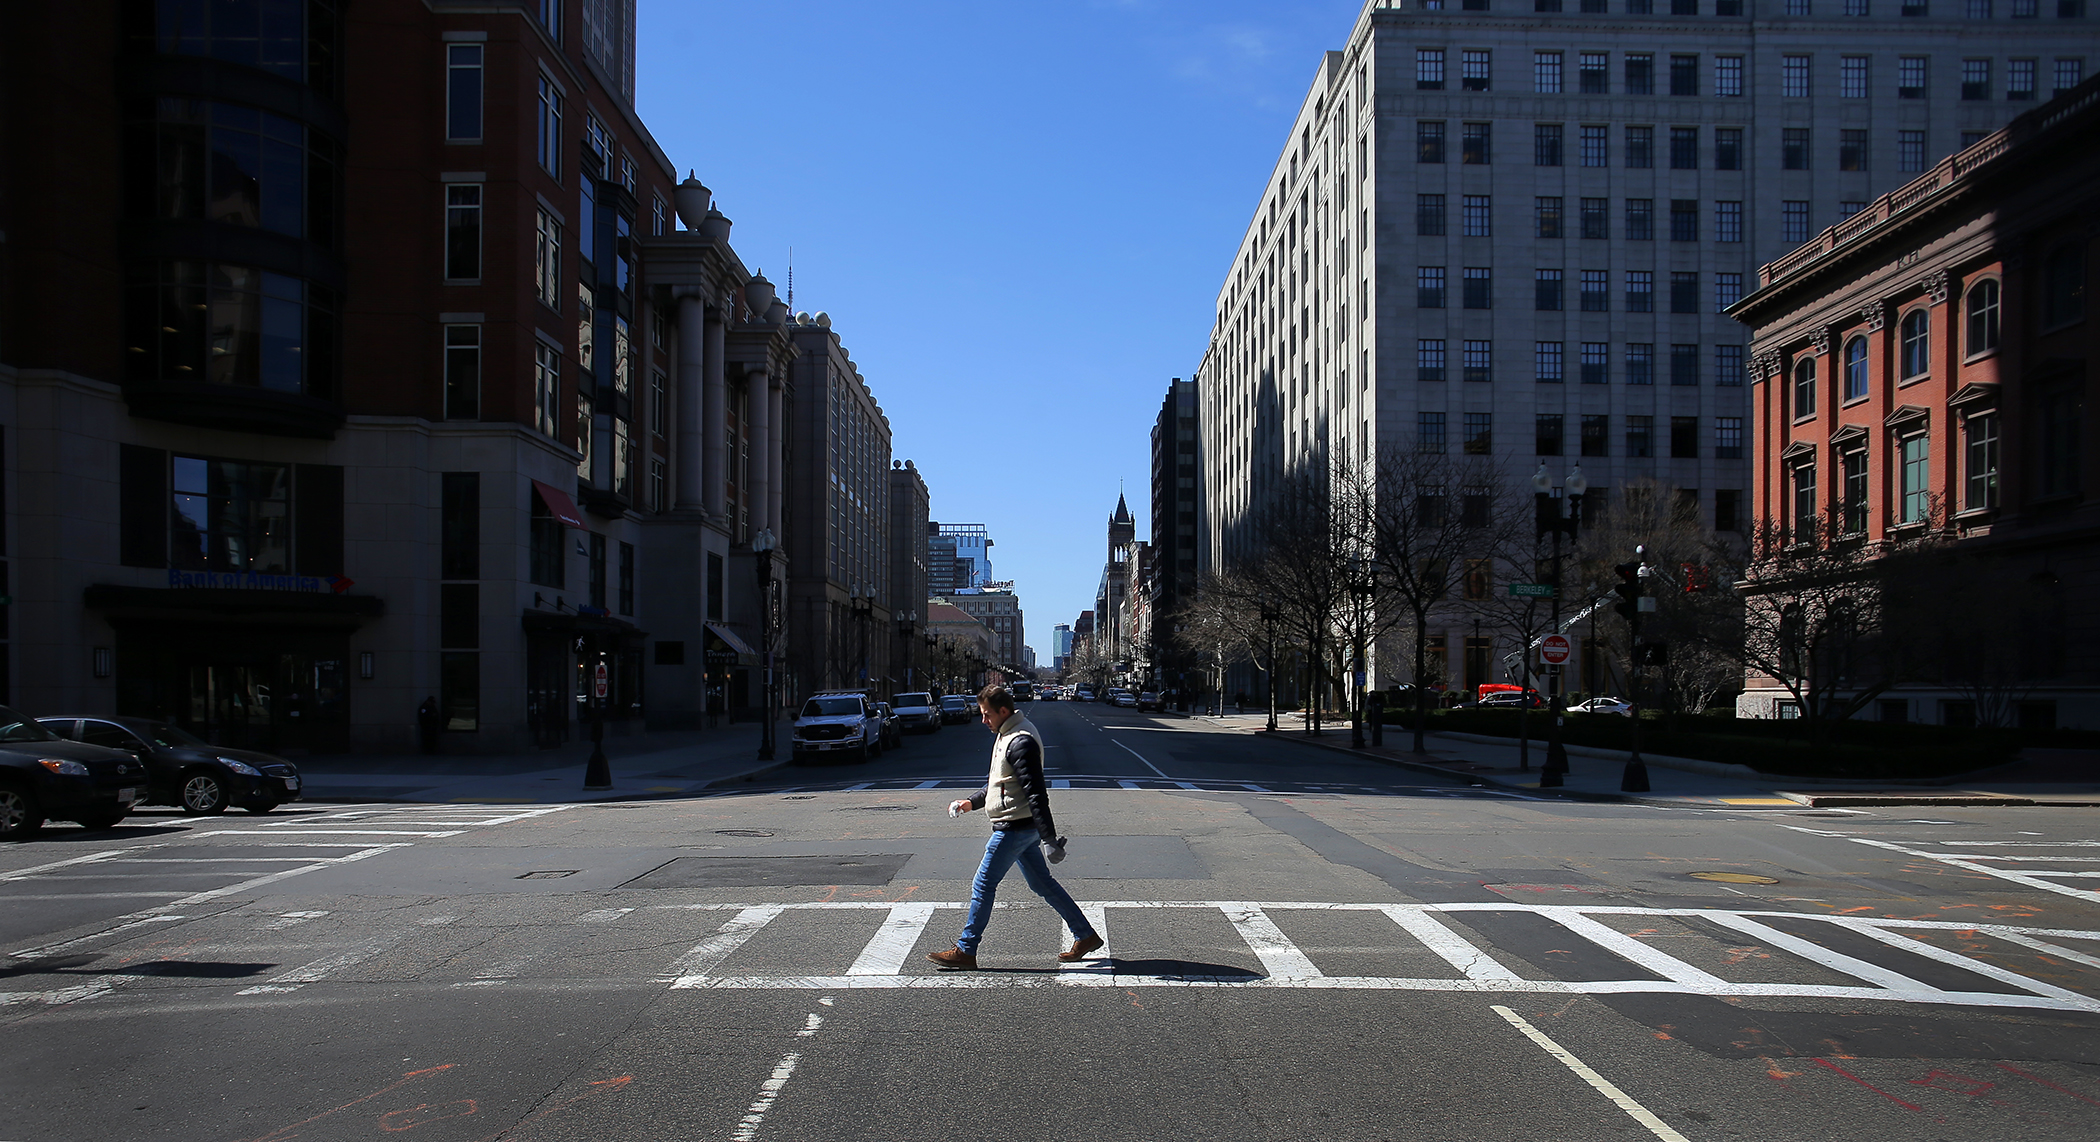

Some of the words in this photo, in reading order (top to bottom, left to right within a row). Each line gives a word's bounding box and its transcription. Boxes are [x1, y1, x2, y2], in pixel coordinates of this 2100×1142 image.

[168, 568, 219, 586] Bank
[223, 570, 243, 586] of
[246, 570, 319, 589] America
[1516, 585, 1546, 595] BERKELEY
